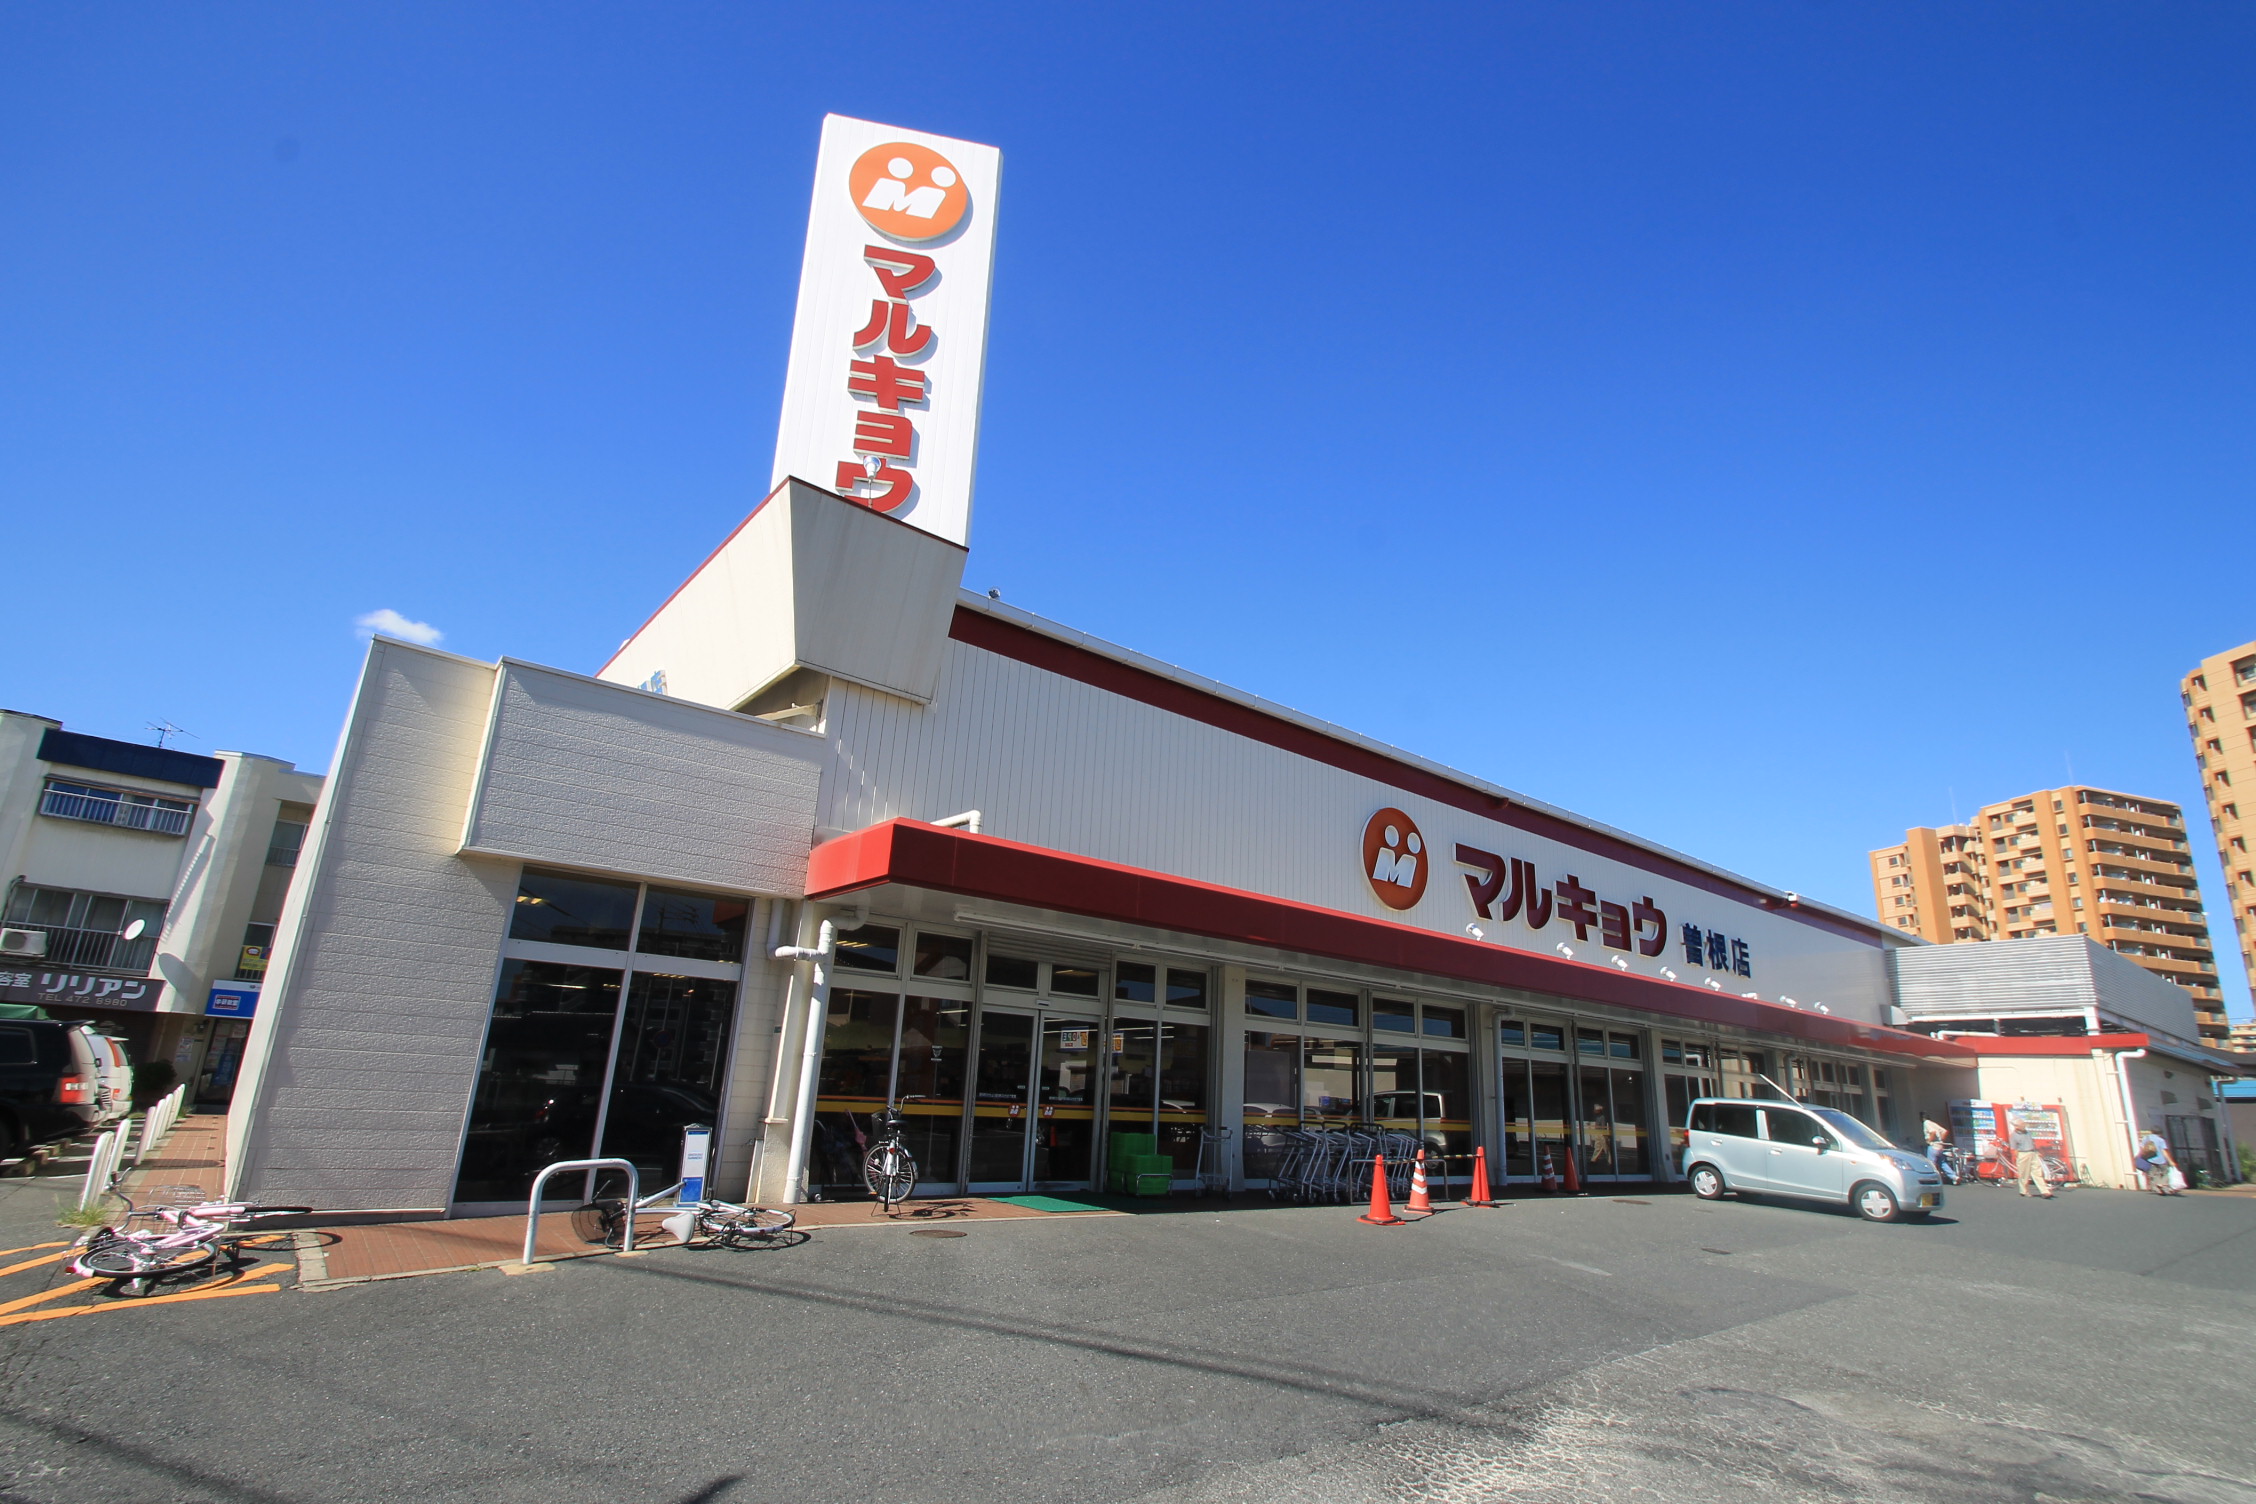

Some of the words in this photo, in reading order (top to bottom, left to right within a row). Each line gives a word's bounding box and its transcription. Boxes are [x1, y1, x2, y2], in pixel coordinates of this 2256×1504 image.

[835, 244, 936, 513] マルキョウ
[1453, 842, 1668, 957] マルキョウ
[38, 992, 62, 1002] TEL
[65, 995, 90, 1004] 472
[41, 973, 147, 999] リリアン
